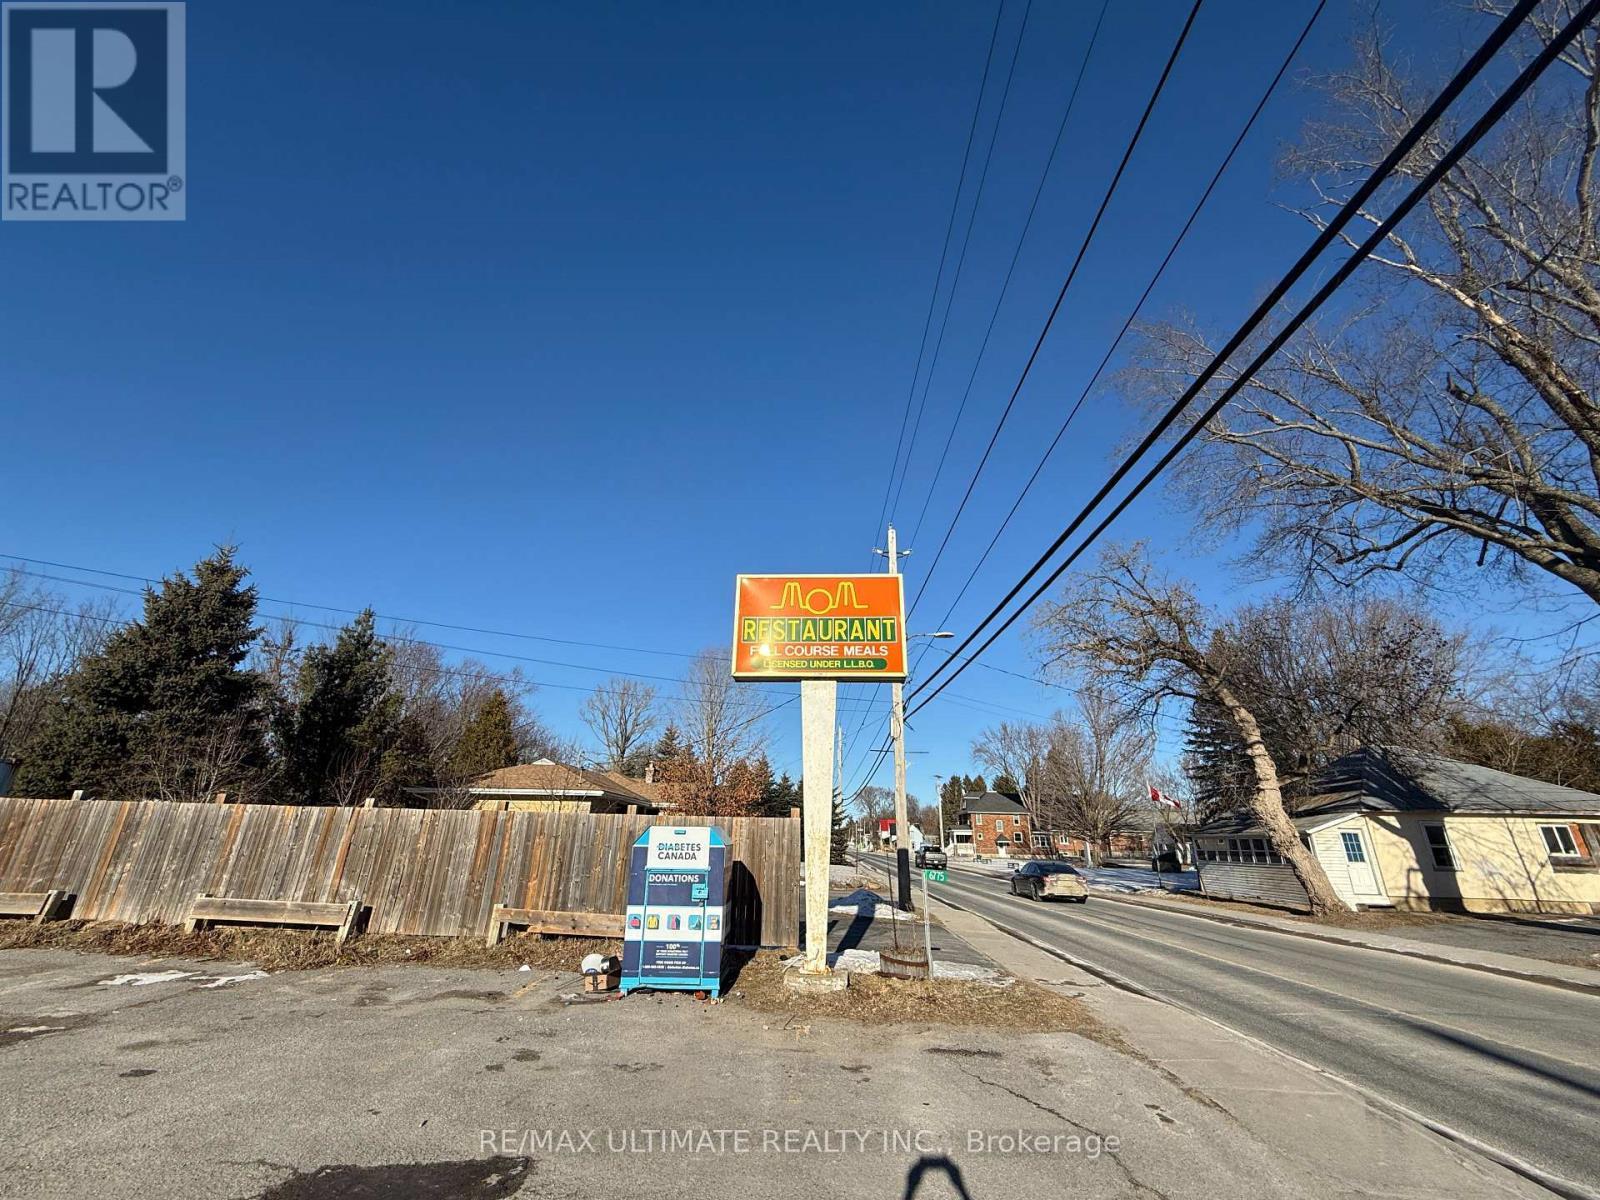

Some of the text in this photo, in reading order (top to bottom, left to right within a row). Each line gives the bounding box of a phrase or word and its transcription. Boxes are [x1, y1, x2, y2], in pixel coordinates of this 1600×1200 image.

[743, 619, 895, 641] RESTAURANT
[784, 645, 839, 657] COURSE
[843, 645, 889, 657] MEALS
[809, 659, 841, 668] UNDER
[658, 842, 701, 851] DIABETES
[657, 852, 697, 860] CANADA
[649, 874, 700, 883] DONATIONS
